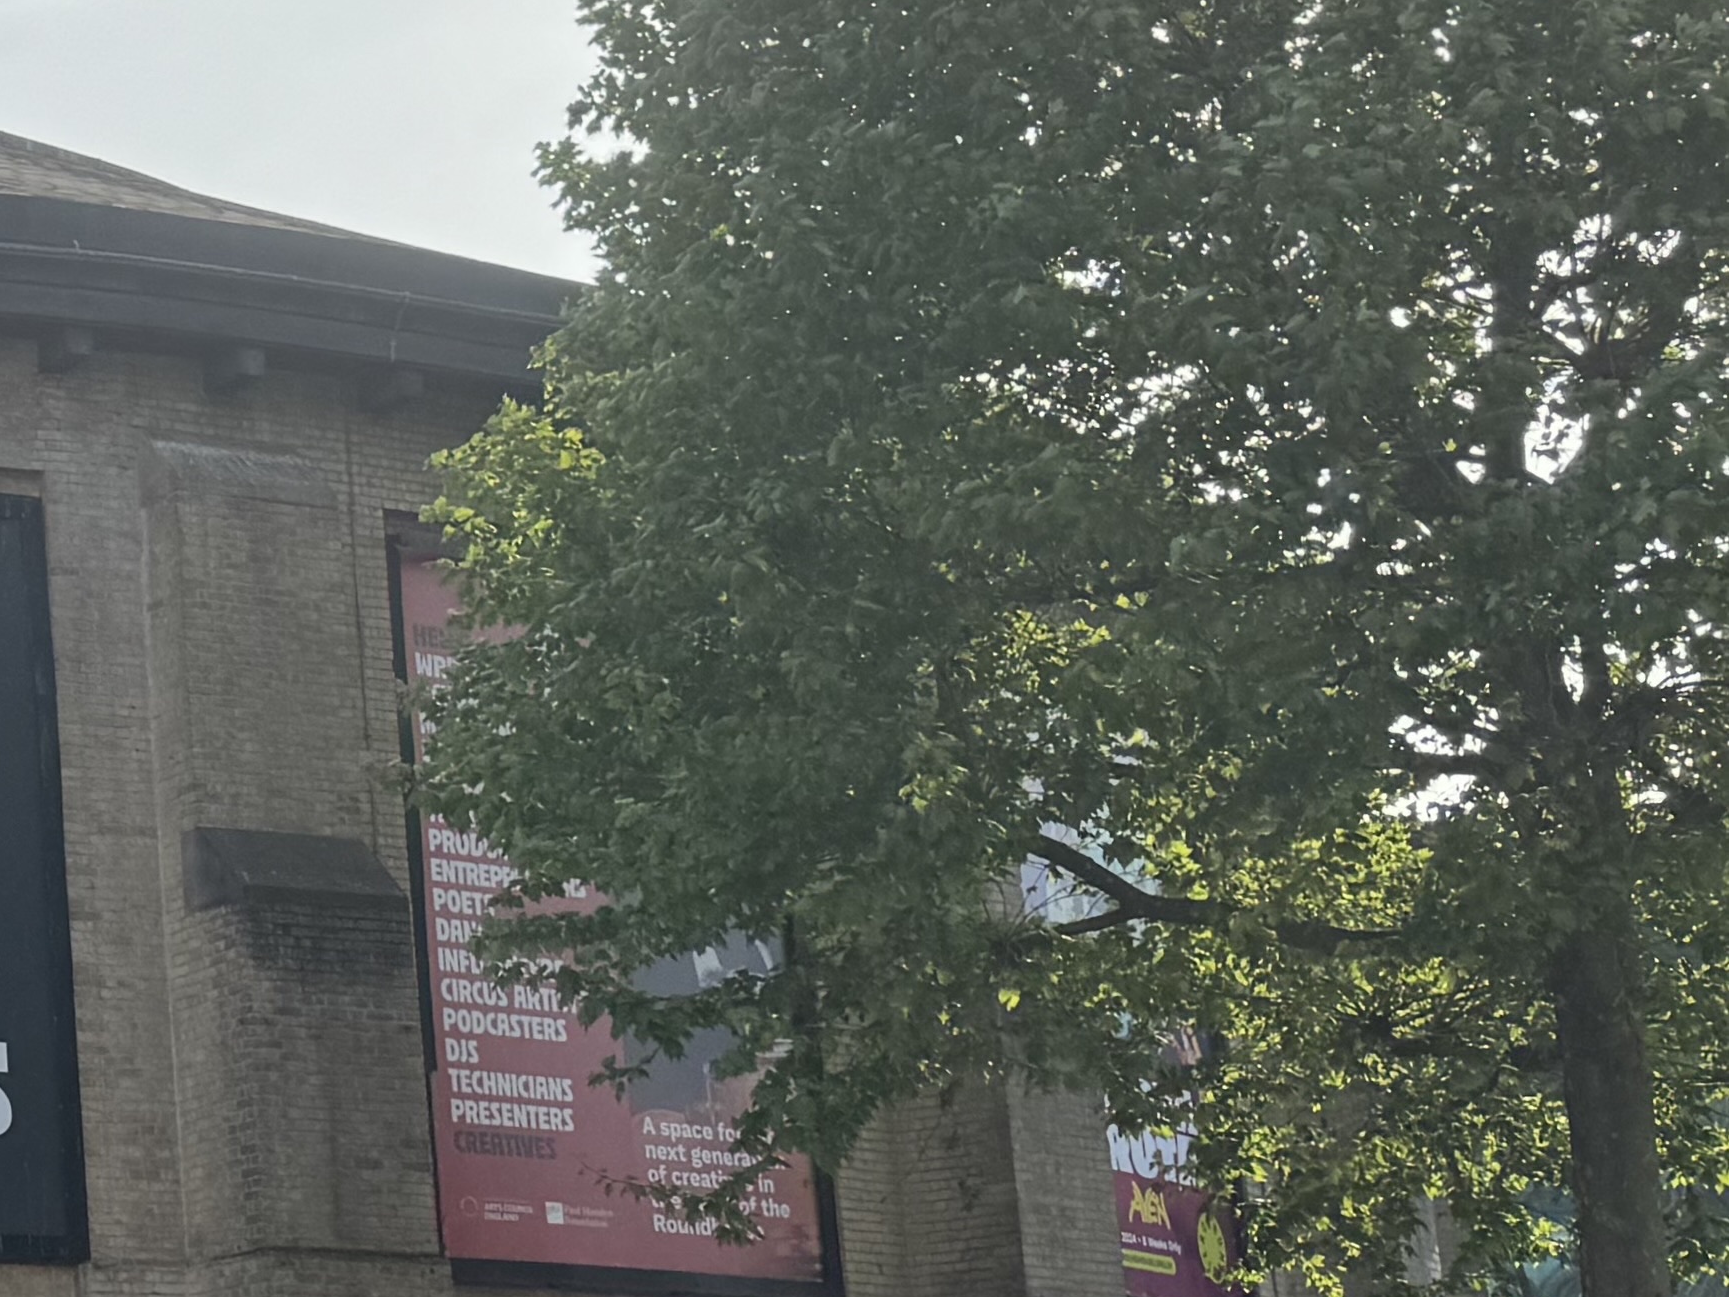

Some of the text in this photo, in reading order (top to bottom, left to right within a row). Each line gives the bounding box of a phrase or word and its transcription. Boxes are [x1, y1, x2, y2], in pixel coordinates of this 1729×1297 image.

[443, 1007, 567, 1042] PODCASTERS
[445, 1037, 479, 1063] DJS
[448, 1068, 573, 1102] TECHNICIANS
[451, 1099, 574, 1131] PRESENTERS
[643, 1116, 655, 1135] A
[660, 1122, 713, 1142] space
[454, 1131, 557, 1159] CREATIVES
[645, 1145, 687, 1162] next
[648, 1165, 774, 1193] of in
[761, 1198, 791, 1218] the
